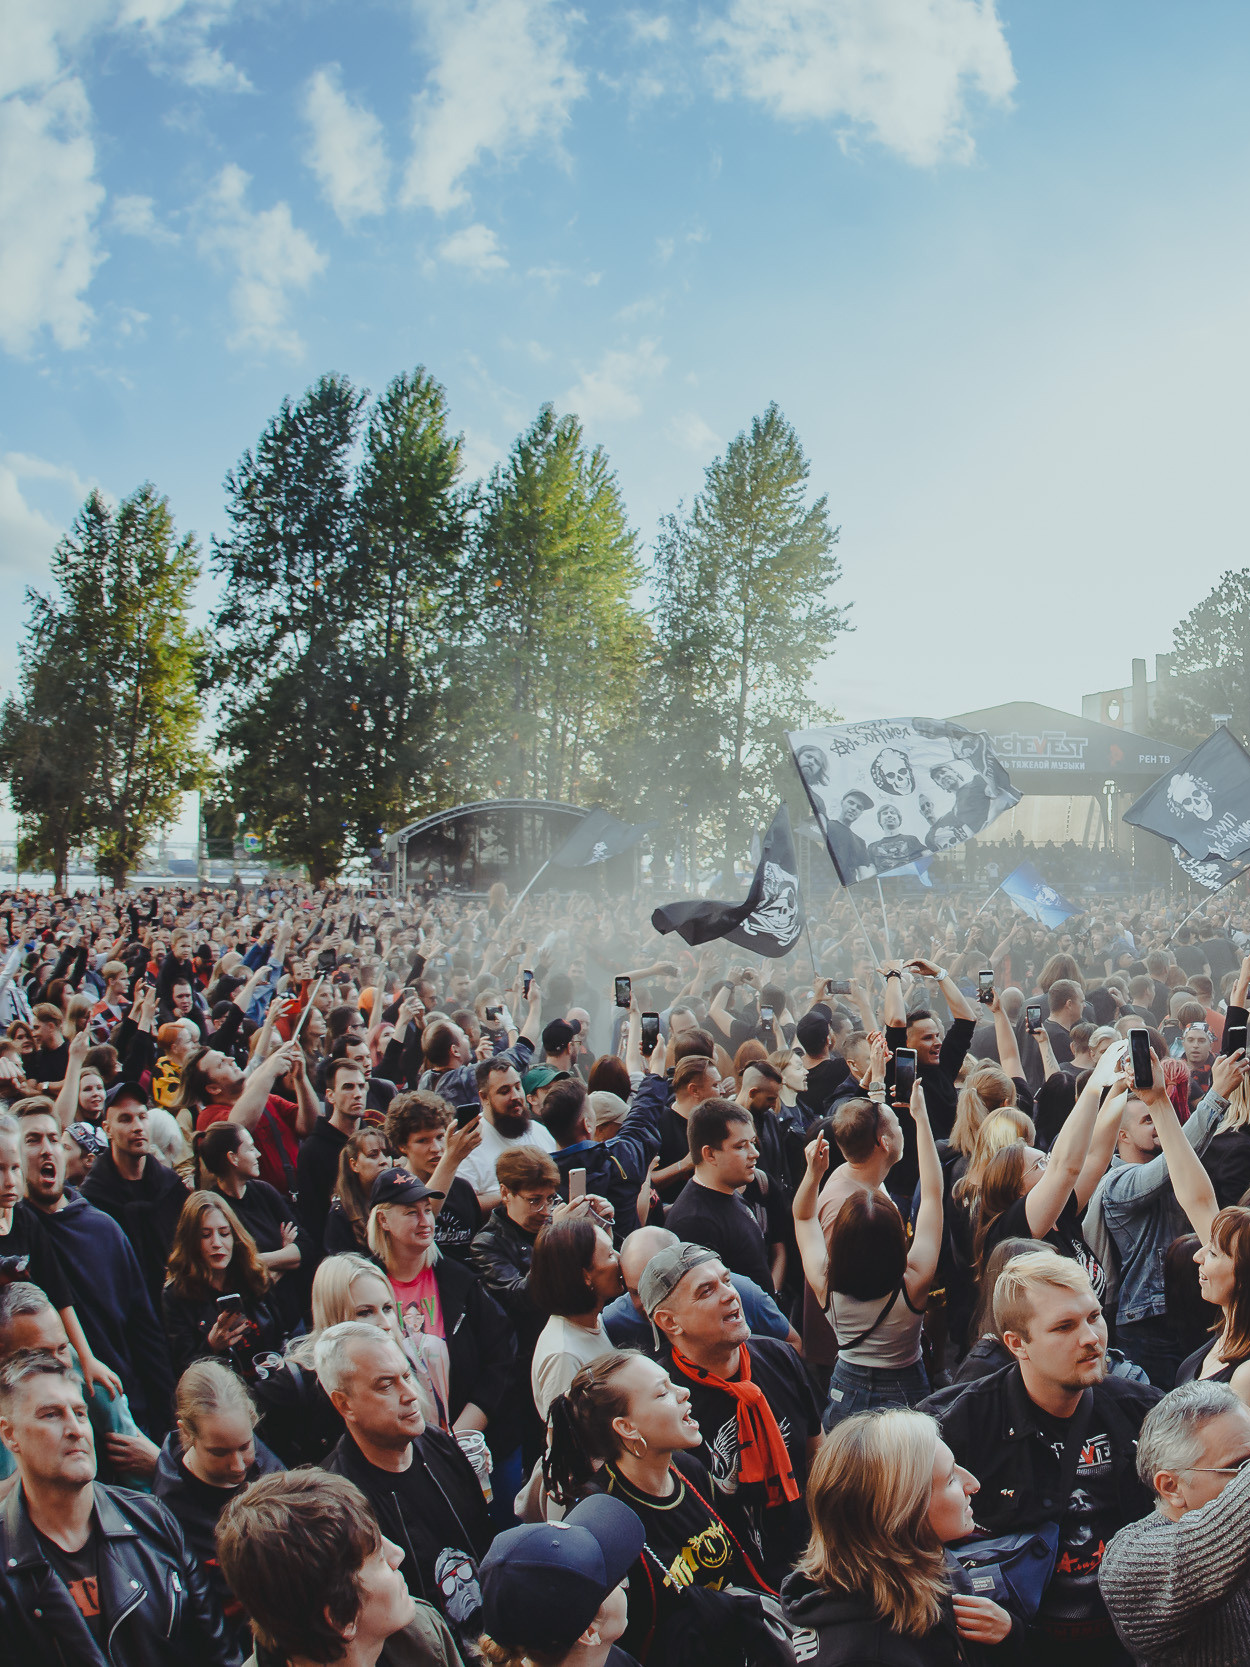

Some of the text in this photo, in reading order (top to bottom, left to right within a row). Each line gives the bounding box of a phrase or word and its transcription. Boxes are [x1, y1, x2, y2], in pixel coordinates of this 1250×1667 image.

[1138, 754, 1171, 764] РЕН ТВ
[1011, 760, 1049, 770] ТЯЖЕЛОЙ
[1050, 761, 1085, 771] МУЗЫКИ
